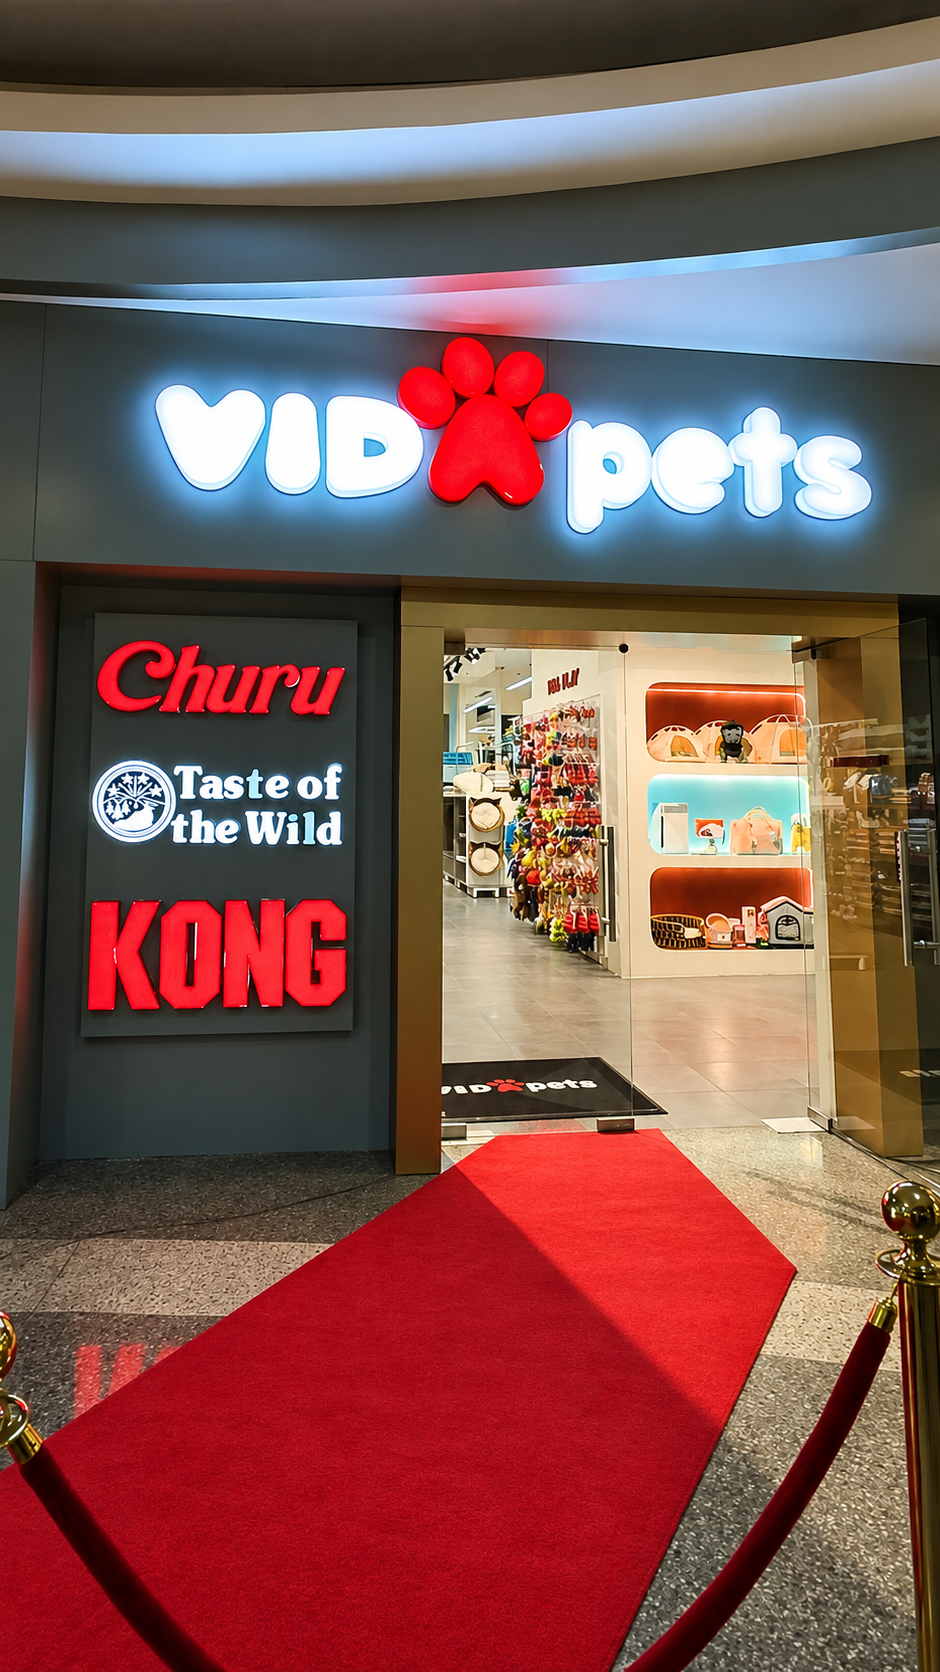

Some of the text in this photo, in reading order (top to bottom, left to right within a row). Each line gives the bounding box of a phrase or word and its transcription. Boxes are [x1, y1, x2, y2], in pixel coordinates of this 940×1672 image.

[567, 407, 873, 533] pets
[97, 640, 346, 715] Churu
[174, 763, 342, 801] Taste of
[171, 810, 342, 847] the Wild
[87, 900, 348, 1010] KONG
[525, 1079, 598, 1092] pets
